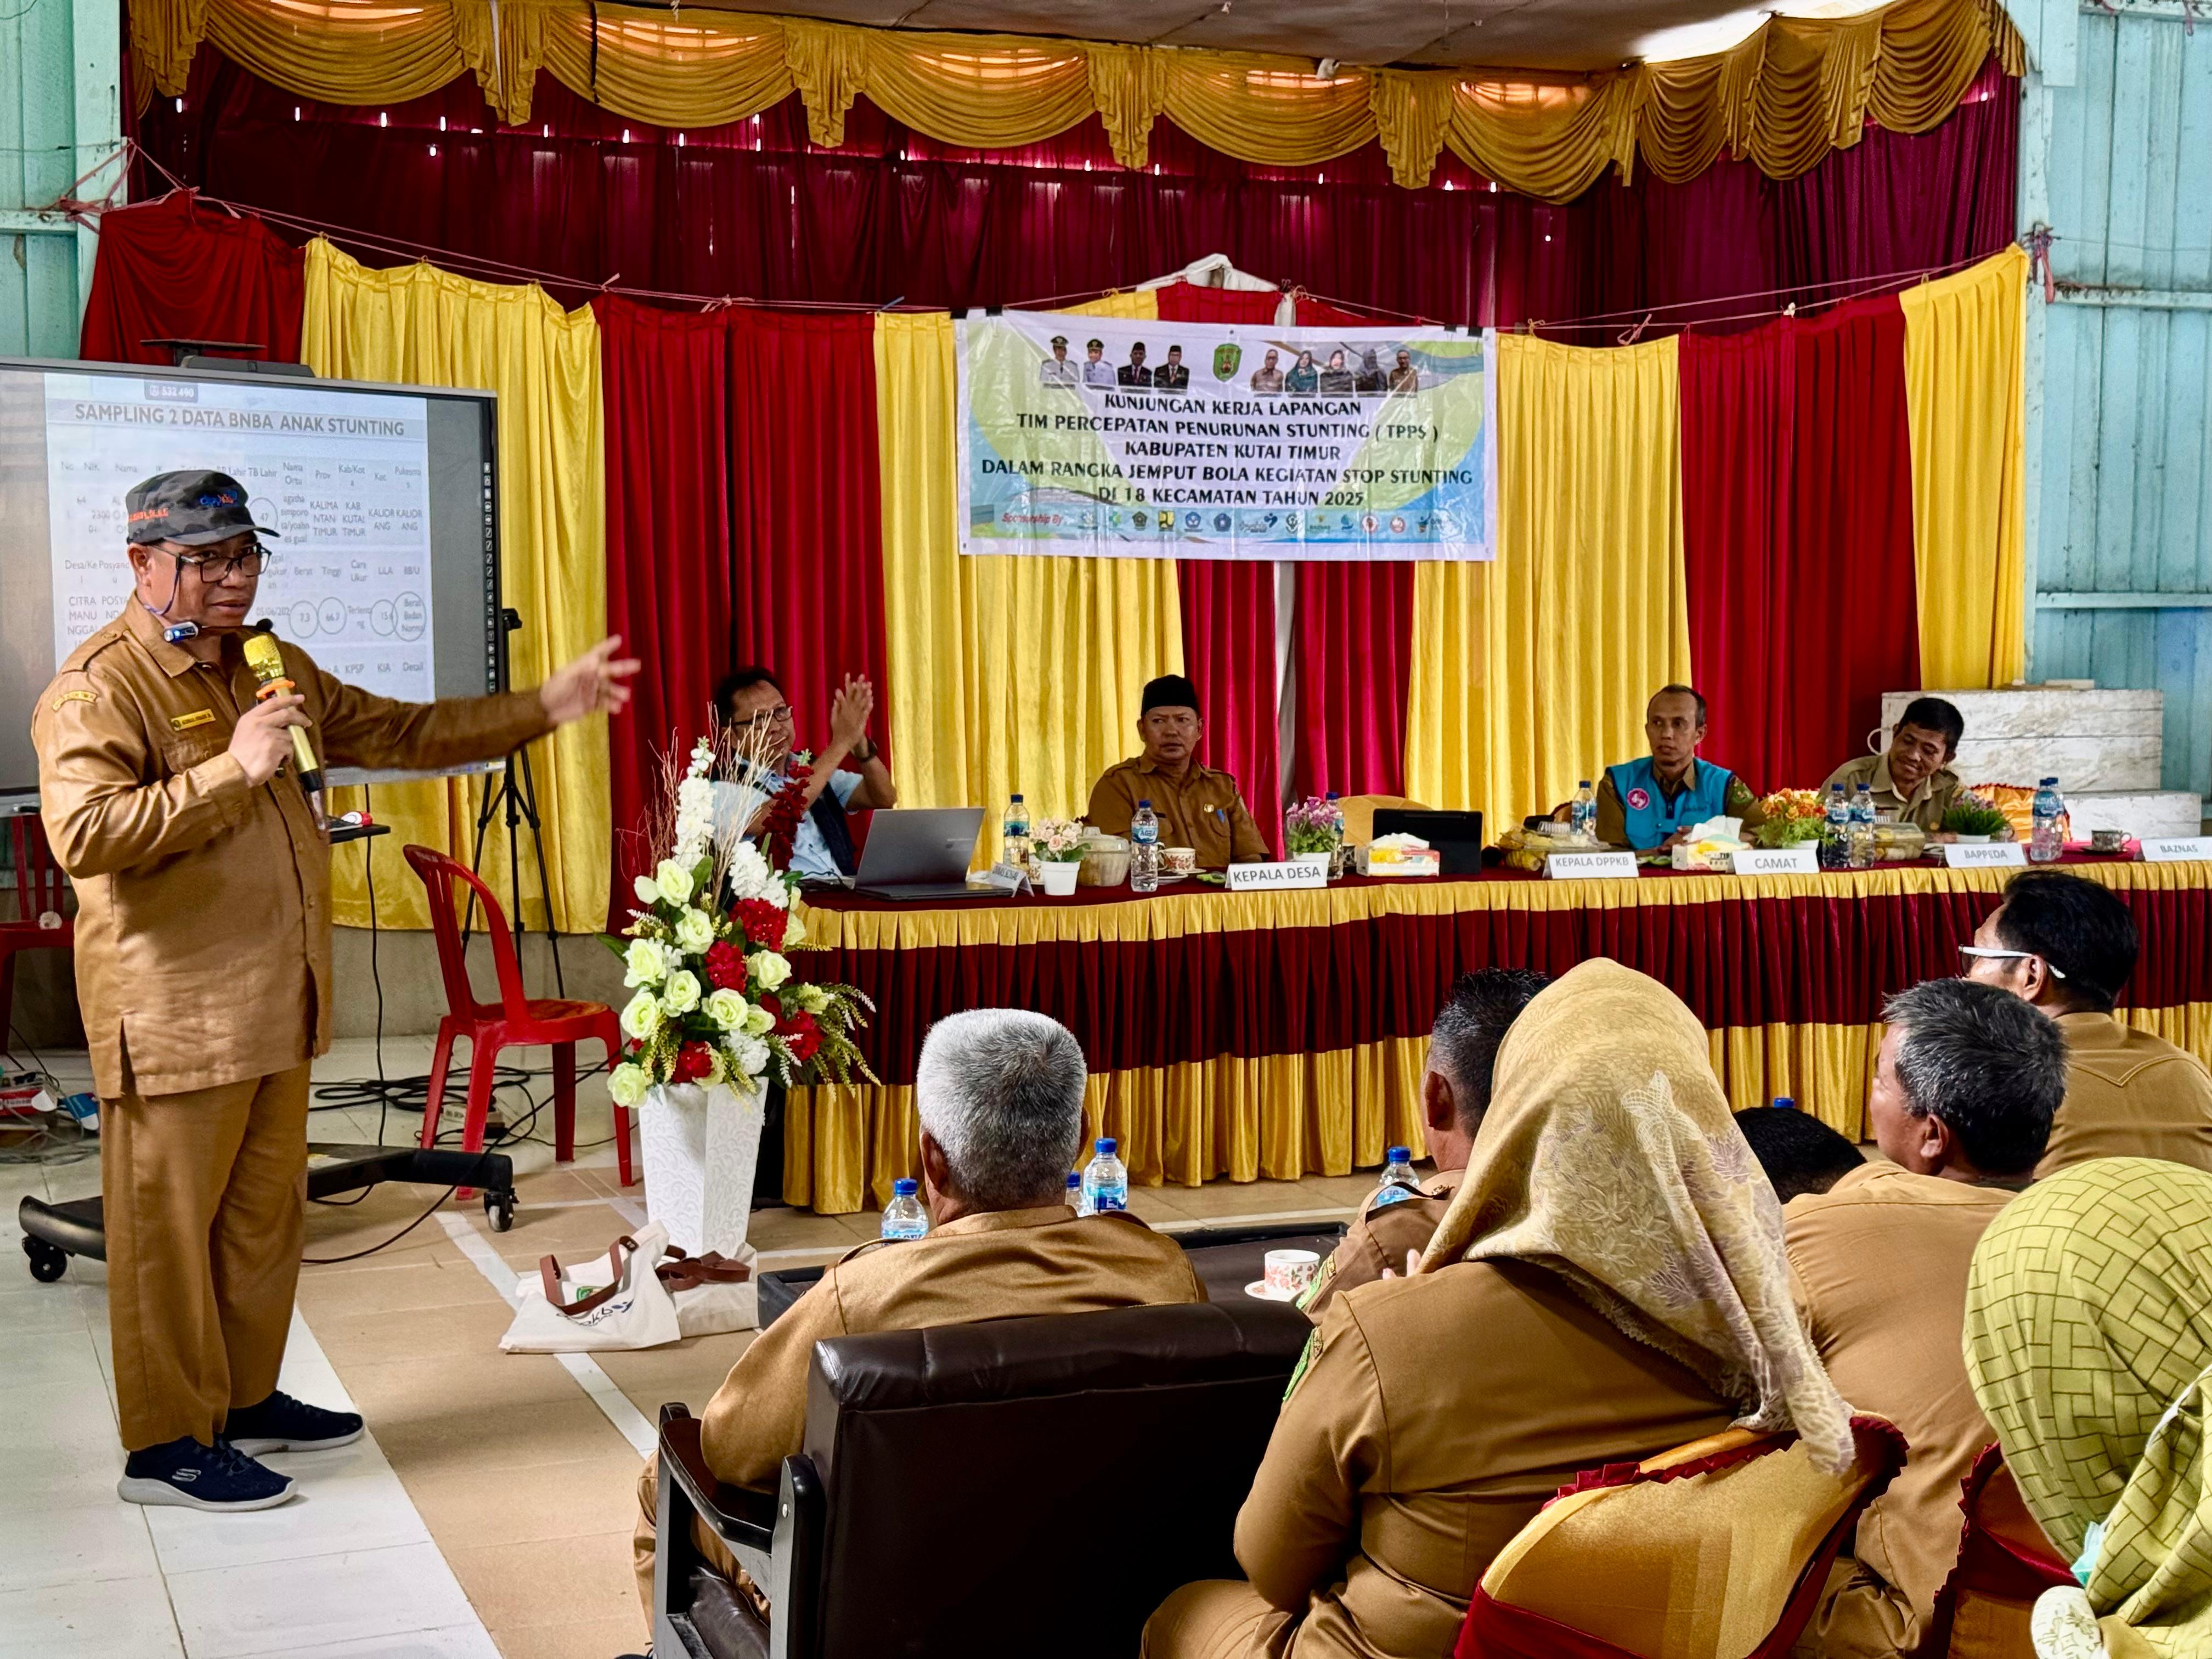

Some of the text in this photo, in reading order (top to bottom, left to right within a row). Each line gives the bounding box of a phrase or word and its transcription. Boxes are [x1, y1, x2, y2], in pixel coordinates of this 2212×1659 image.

[1104, 394, 1362, 416] KUNJUNGAN KERJA LAPANGAN
[75, 404, 405, 436] SAMPLING 2 DATA BNBA ANAK STUNTING
[1017, 413, 1048, 429] TIM
[1055, 415, 1169, 434] PERCEPATAN
[1176, 421, 1280, 437] PENURUNAN
[1286, 423, 1370, 438] STUNTING
[1386, 424, 1427, 439] TPPS
[1126, 441, 1341, 461] KABUPATEN KUTAI TIMUR
[982, 459, 1473, 485] DALAM RANGKA JEMPUT BOLA KEGIATAN STOP STUNTING
[1098, 486, 1365, 506] DI 18 KECAMATAN TAHUN 2025
[69, 596, 97, 607] CITRA
[69, 610, 98, 621] MANU
[1963, 848, 2009, 860] BAPPEDA
[2160, 843, 2199, 854] BAZNAS
[1555, 855, 1630, 867] KEPALA DPPKB
[1754, 857, 1798, 870] CAMAT
[1233, 866, 1322, 884] KEPALA DESA
